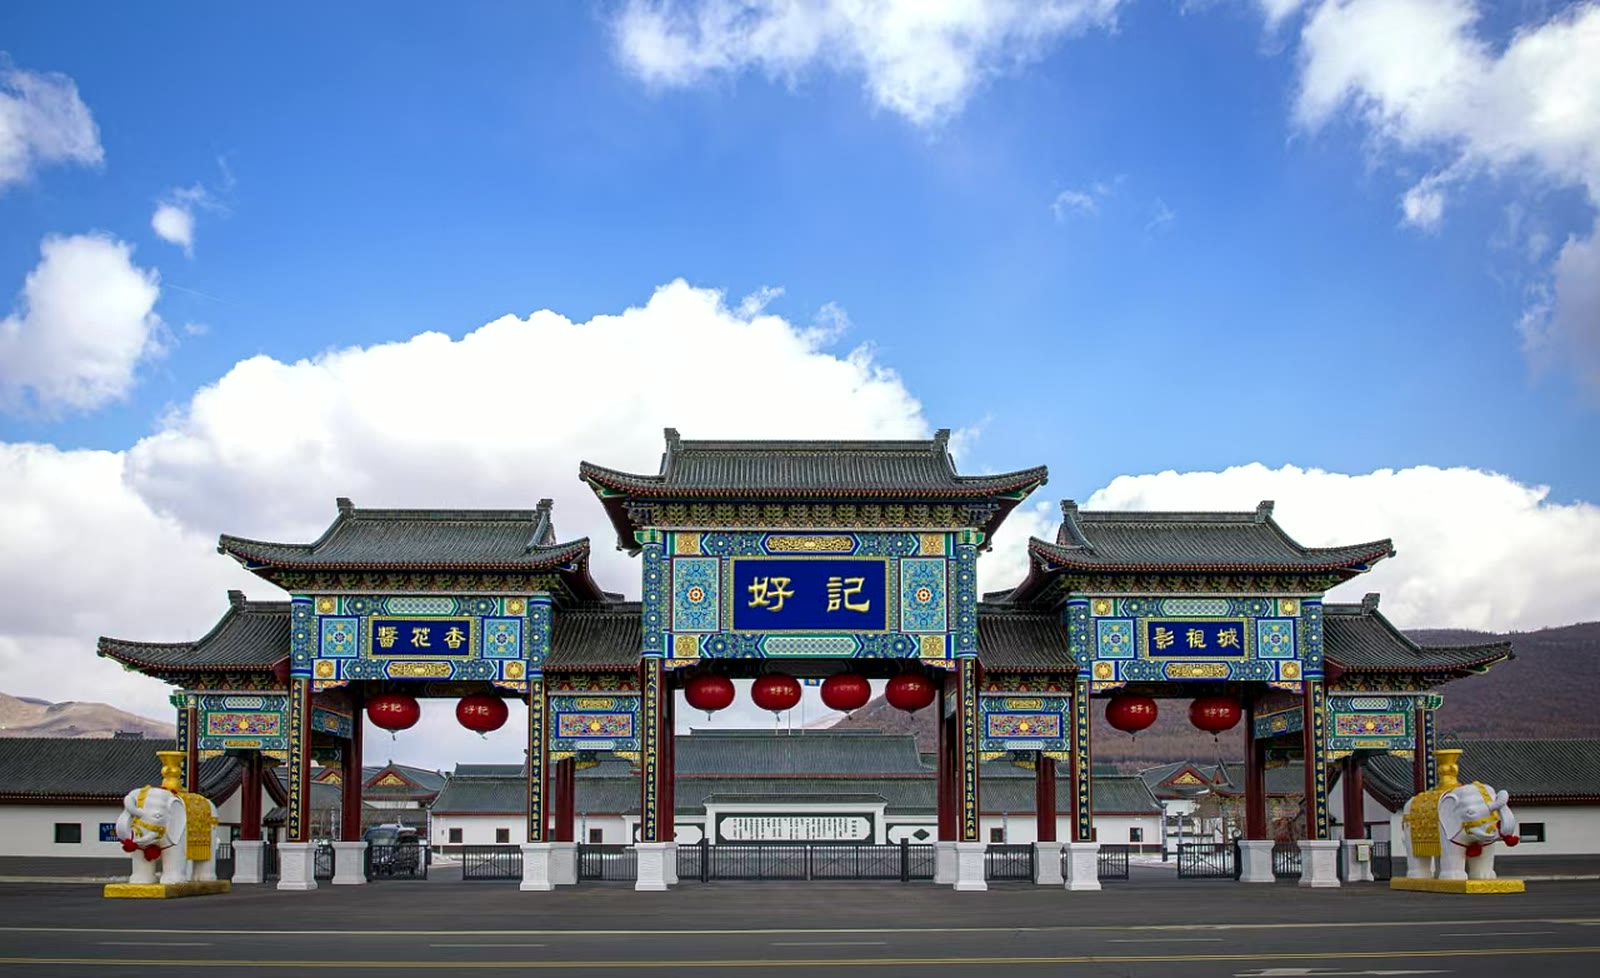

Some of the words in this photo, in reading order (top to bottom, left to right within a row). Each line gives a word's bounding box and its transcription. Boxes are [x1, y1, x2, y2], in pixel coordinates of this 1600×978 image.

[748, 575, 870, 612] 好記
[1153, 626, 1240, 650] 影視城
